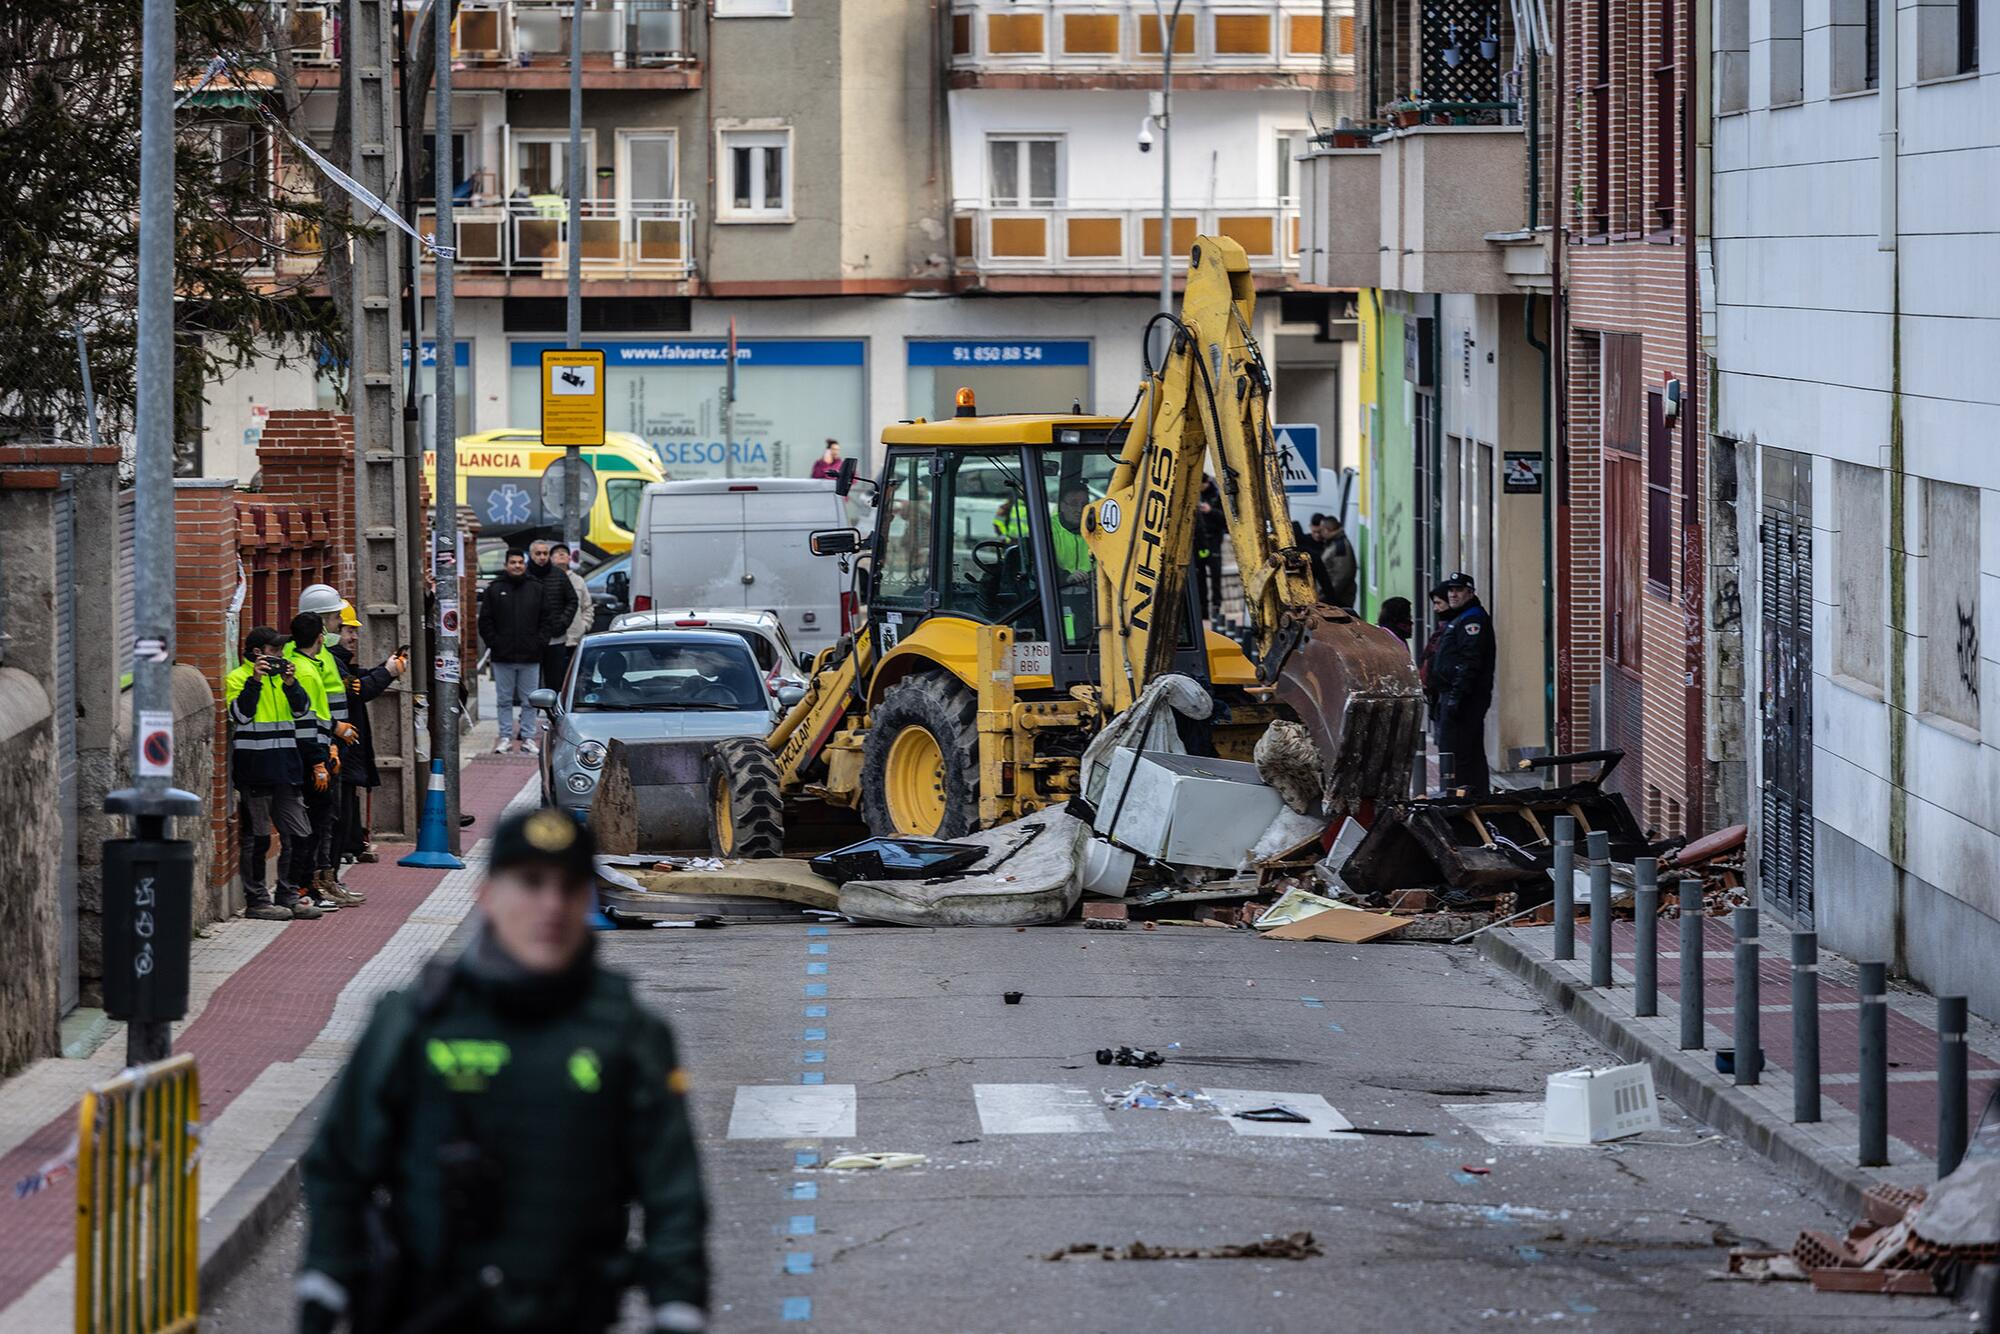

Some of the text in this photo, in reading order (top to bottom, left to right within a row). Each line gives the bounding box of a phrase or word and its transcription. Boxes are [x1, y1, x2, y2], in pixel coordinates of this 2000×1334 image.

[620, 345, 752, 359] www.falvarez.cm
[953, 347, 970, 360] 91
[1023, 347, 1042, 360] 54
[646, 426, 697, 436] LABORAL
[1102, 503, 1118, 529] 40
[1130, 445, 1173, 631] NH95
